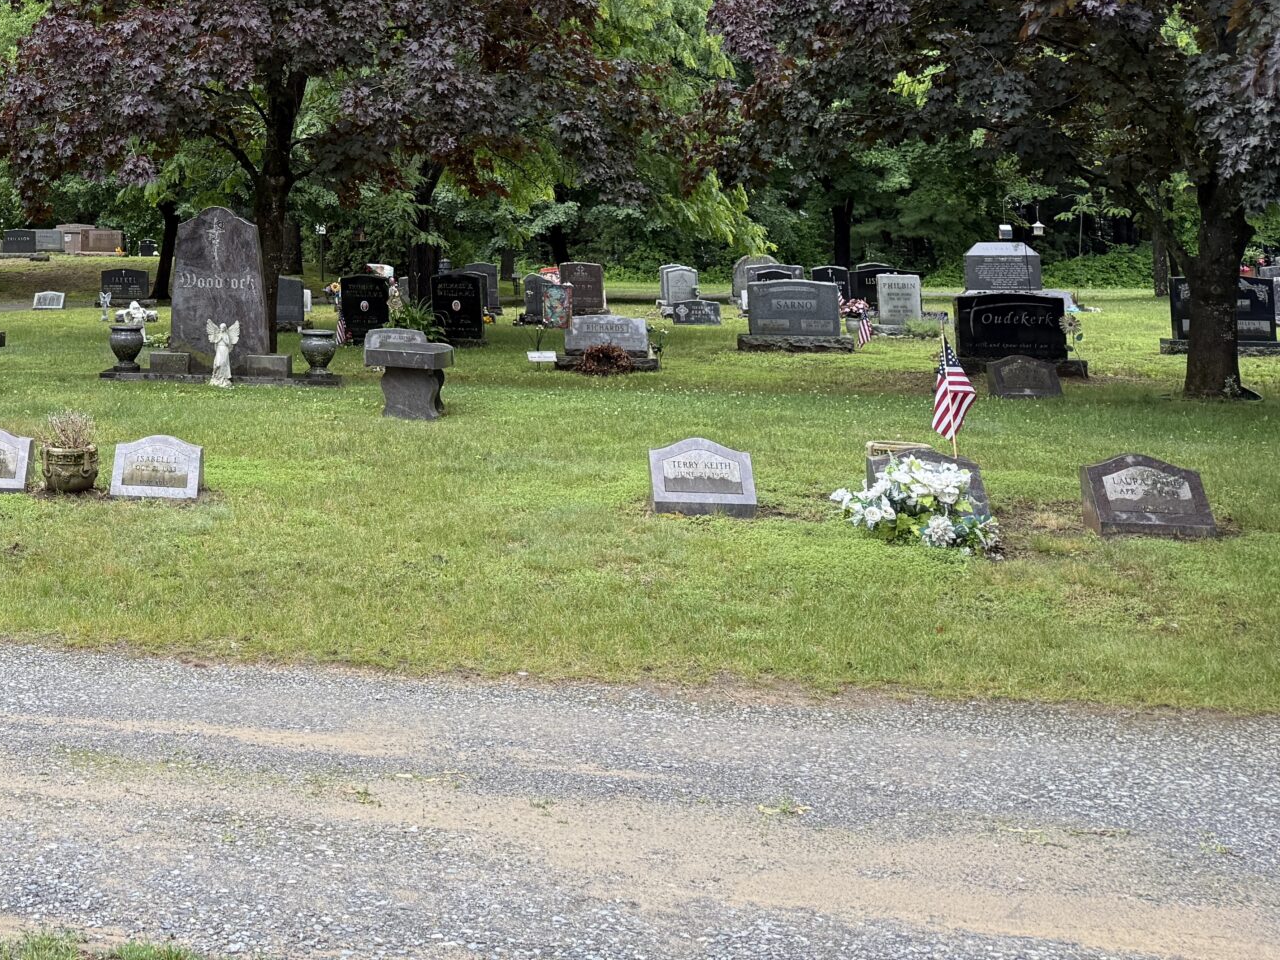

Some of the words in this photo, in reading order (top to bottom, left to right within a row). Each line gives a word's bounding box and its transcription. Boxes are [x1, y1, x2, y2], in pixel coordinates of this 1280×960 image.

[865, 277, 877, 285] LIS
[882, 282, 916, 290] PHILBIN
[776, 301, 813, 310] SARNO
[981, 311, 1055, 327] Oudekerk
[586, 324, 625, 332] RICHARDS
[671, 460, 700, 469] TERRY
[704, 461, 731, 470] KEITH
